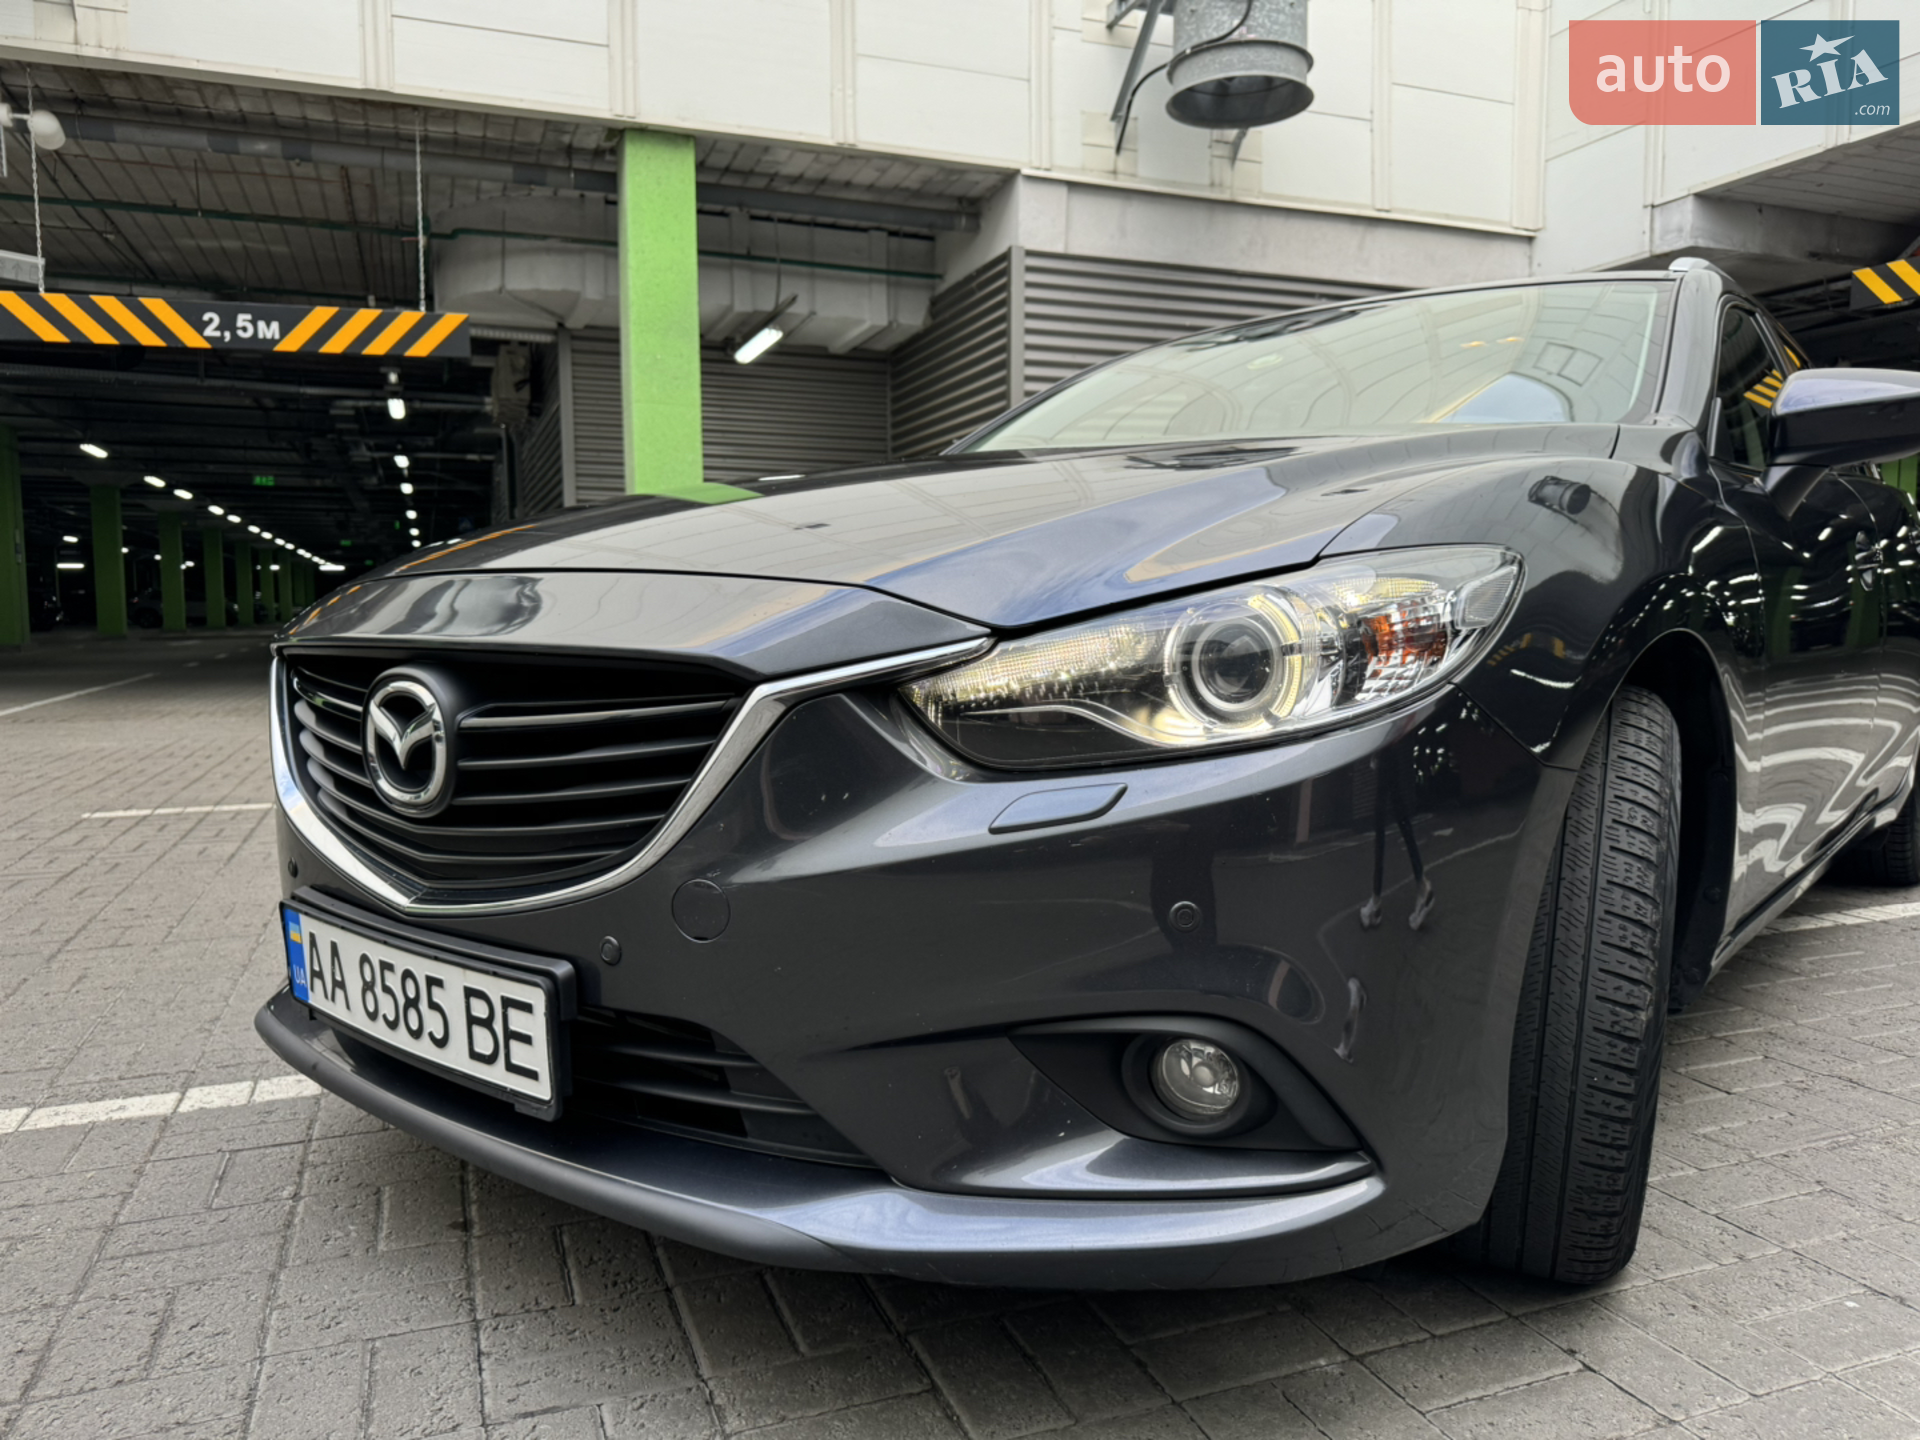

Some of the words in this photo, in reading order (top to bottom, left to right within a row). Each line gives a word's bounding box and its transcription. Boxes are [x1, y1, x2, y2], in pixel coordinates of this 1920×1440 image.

[293, 964, 307, 988] UA
[308, 931, 351, 1012] AA
[359, 952, 450, 1049] 8585
[463, 984, 539, 1082] BE
